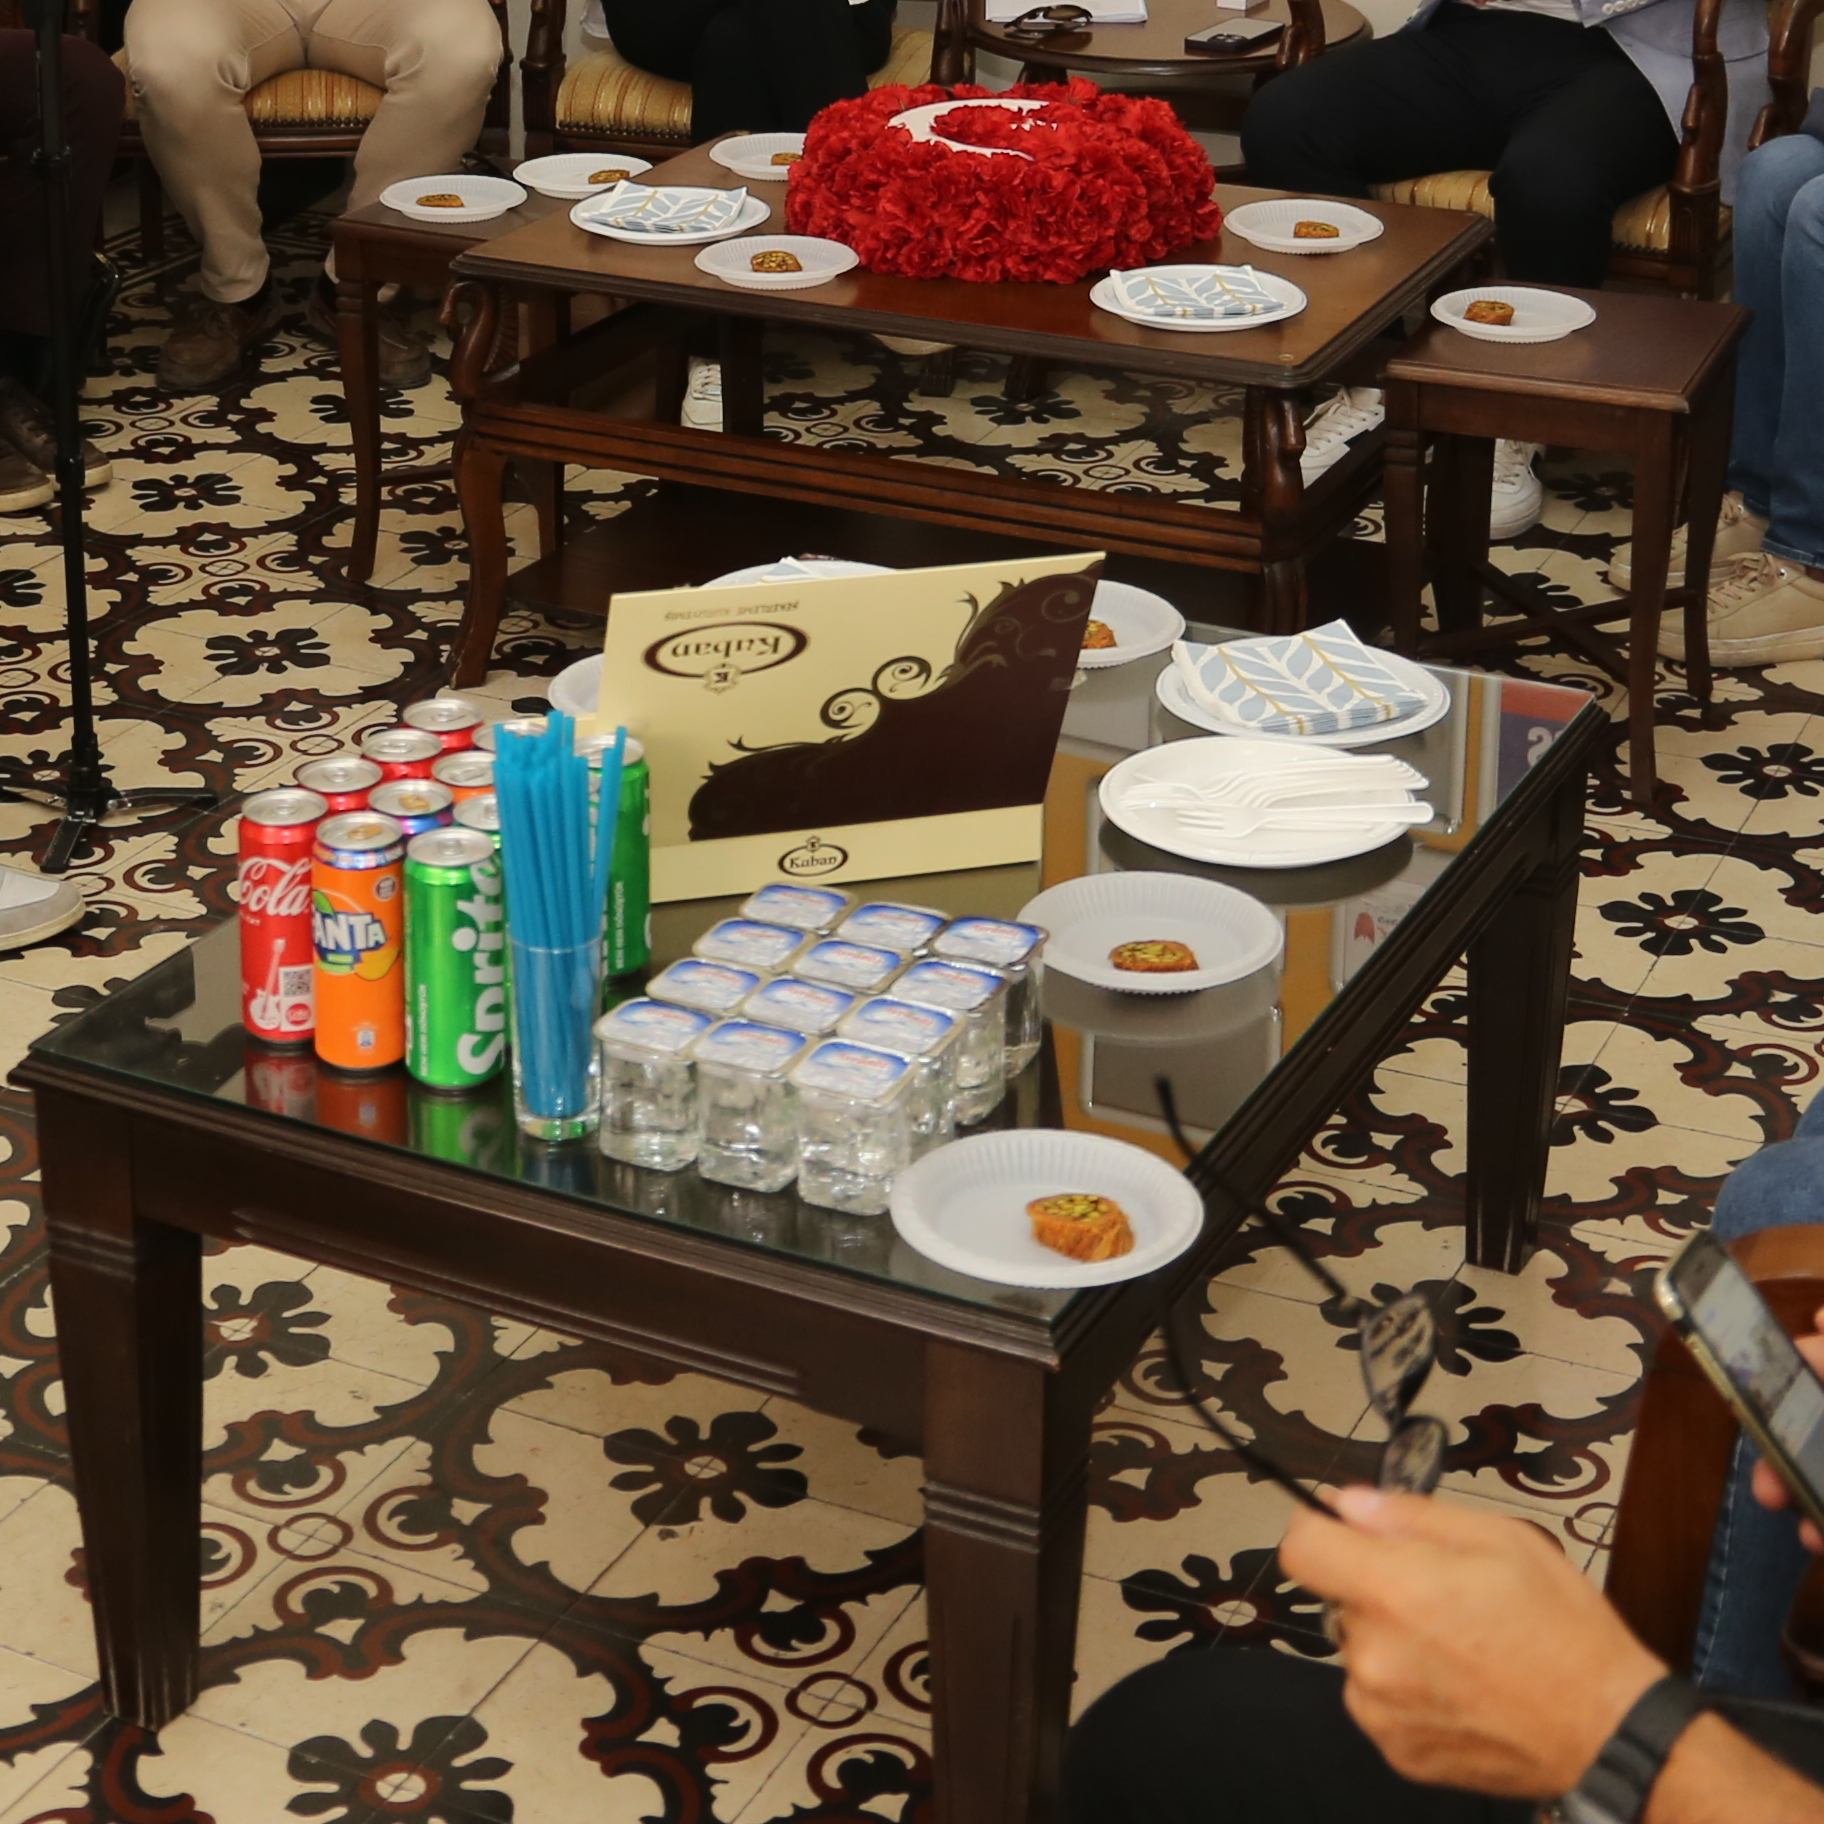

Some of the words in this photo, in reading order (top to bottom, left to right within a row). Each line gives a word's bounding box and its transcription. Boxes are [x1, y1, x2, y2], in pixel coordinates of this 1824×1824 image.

[670, 635, 783, 658] Kuban
[789, 856, 838, 869] Kuban
[239, 857, 313, 916] Cola
[312, 909, 388, 951] ANTA
[452, 857, 504, 1074] Sprite
